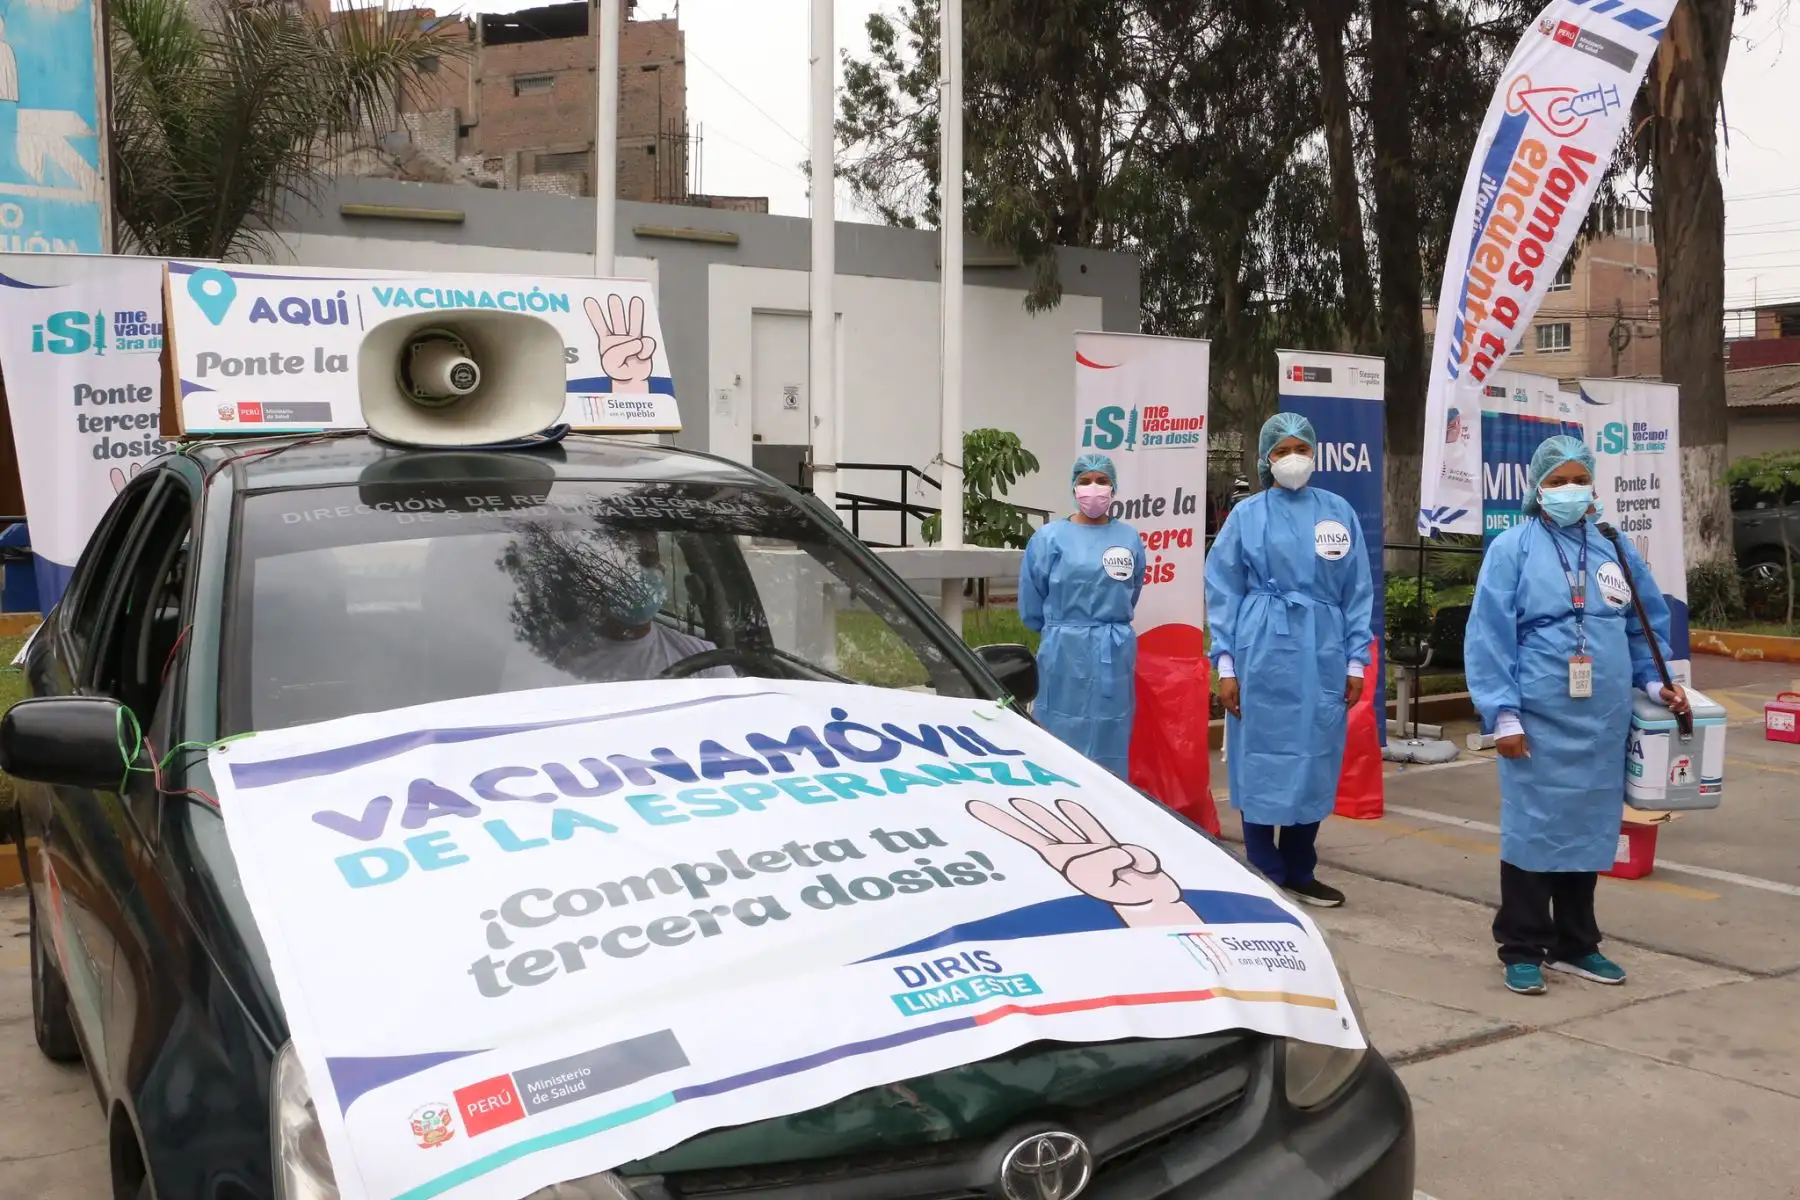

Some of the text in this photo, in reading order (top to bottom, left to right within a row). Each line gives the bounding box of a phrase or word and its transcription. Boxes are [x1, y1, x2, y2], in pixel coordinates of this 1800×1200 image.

[1558, 28, 1575, 40] PERÚ
[1508, 144, 1598, 293] Vamos
[249, 289, 350, 326] AQUÍ
[372, 285, 571, 313] VACUNACIÓN
[114, 311, 147, 324] me
[1491, 296, 1520, 330] a
[114, 322, 163, 337] vacu
[115, 338, 145, 350] 3ra
[195, 347, 349, 378] Ponte la
[1469, 331, 1506, 383] tu
[73, 383, 153, 406] Ponte
[607, 399, 654, 411] Siempre
[77, 412, 161, 433] tercer
[240, 408, 260, 416] PERÚ
[625, 410, 656, 419] pueblo
[1142, 415, 1205, 432] vacuno!
[1143, 405, 1169, 419] me
[1142, 431, 1200, 446] 3ra dosis
[1632, 422, 1647, 432] me
[92, 433, 168, 460] dosis
[1314, 442, 1372, 473] INSA
[1483, 462, 1530, 500] MIN
[1614, 475, 1647, 493] Ponte
[281, 497, 447, 525] DIRECCIÓN
[464, 495, 505, 507] DE
[396, 511, 435, 524] DE
[631, 506, 697, 520] ESTE
[1109, 487, 1197, 520] onte la
[1616, 498, 1661, 513] tercera
[1621, 513, 1652, 532] dosis
[1314, 532, 1350, 544] MINSA
[1103, 557, 1133, 567] MINSA
[1142, 555, 1176, 586] sis
[311, 706, 1027, 842] VACUNAMÓVIL
[333, 760, 1081, 889] DE LA ESPERANZA
[479, 827, 949, 950] ¡Completa tu
[466, 850, 1006, 998] tercera dosis!
[1220, 936, 1299, 956] Siempre
[893, 950, 1003, 989] DIRIS
[1237, 957, 1253, 966] con
[1262, 955, 1307, 972] pueblo
[902, 976, 1033, 1012] LIMA ESTE
[527, 1063, 592, 1094] Ministerio
[467, 1088, 513, 1117] PERÚ
[532, 1079, 587, 1105] de Salud
